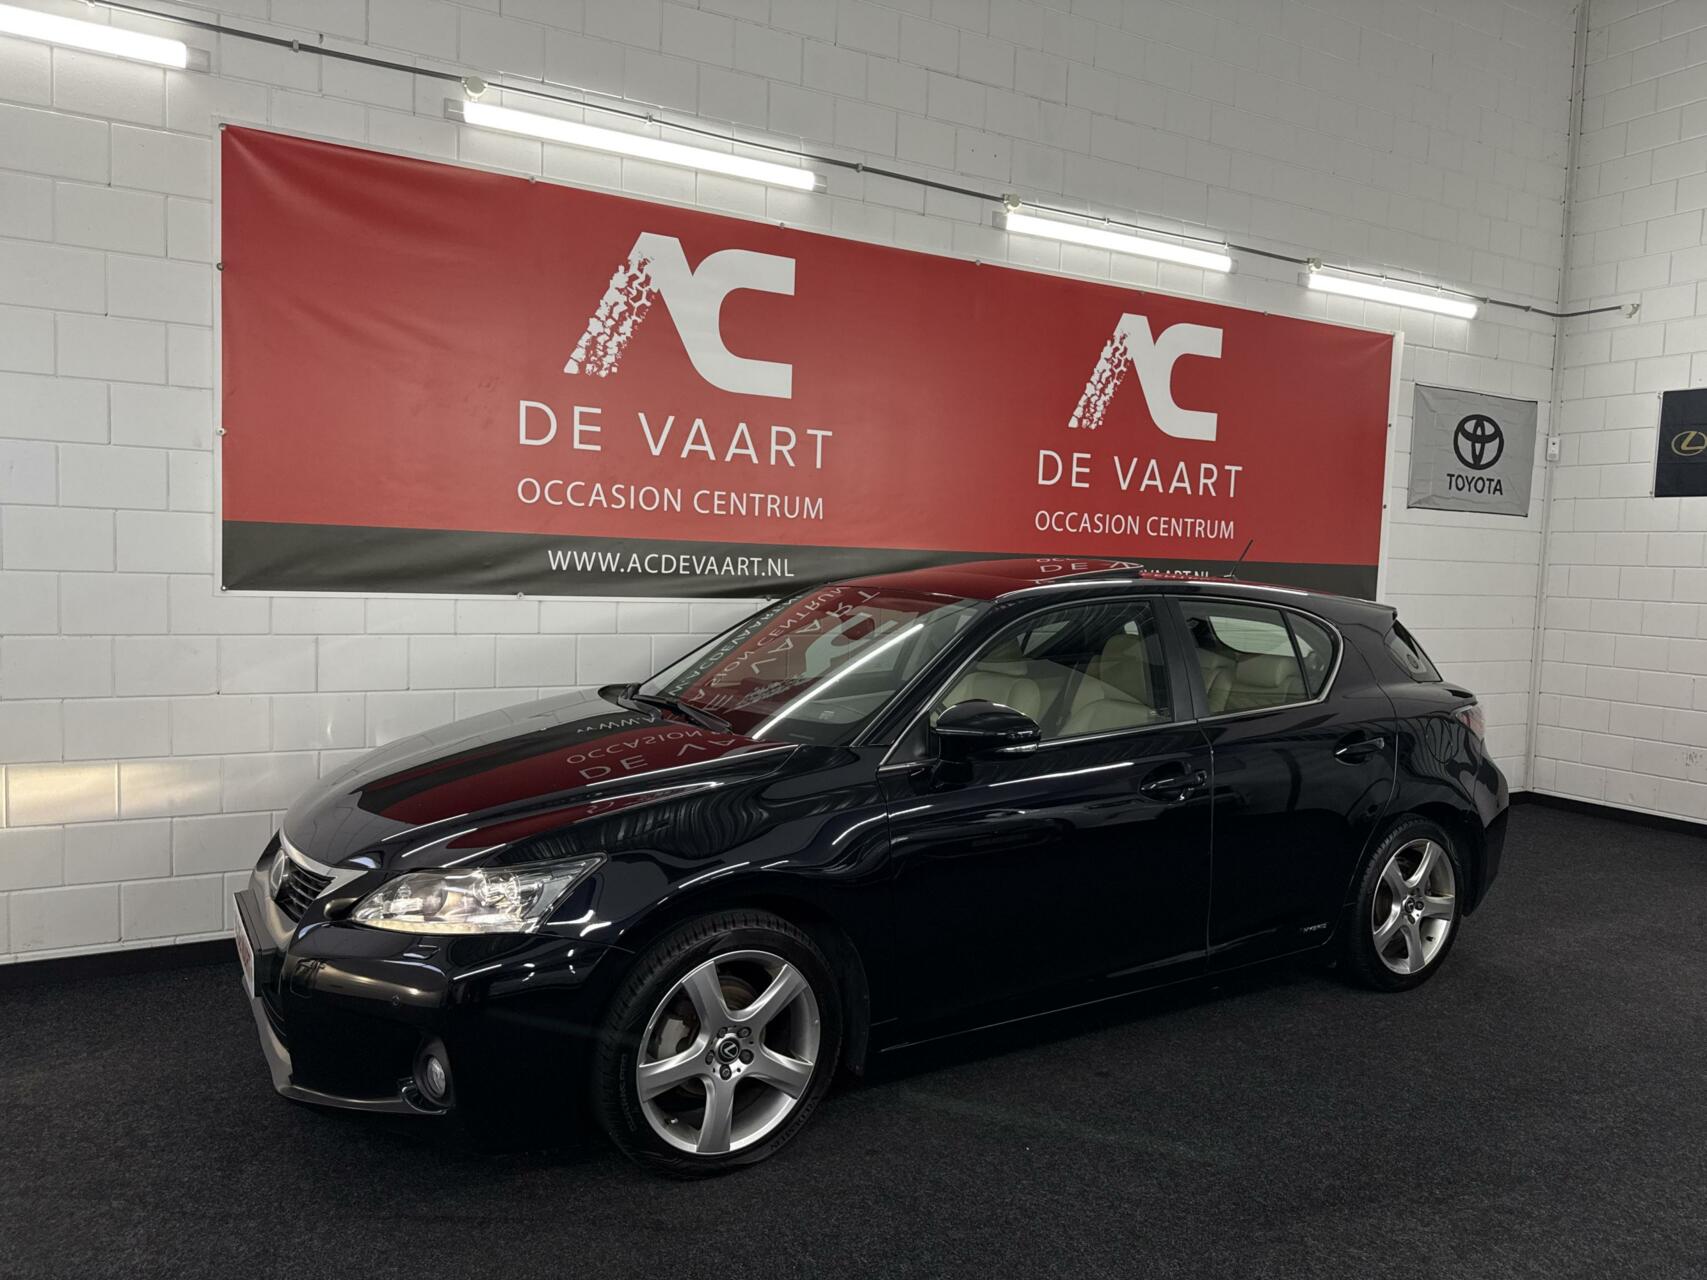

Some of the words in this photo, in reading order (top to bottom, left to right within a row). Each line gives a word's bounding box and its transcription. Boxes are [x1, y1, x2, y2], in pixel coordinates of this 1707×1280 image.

[563, 231, 796, 399] AC
[1068, 312, 1223, 442] AC
[518, 400, 602, 452] DE
[638, 411, 833, 469] VAART
[1037, 449, 1091, 488] DE
[1113, 455, 1243, 498] VAART
[1446, 473, 1503, 496] TOYOTA
[516, 477, 682, 513] OCCASION
[693, 489, 824, 521] CENTRUM
[1034, 510, 1140, 535] OCCASION
[1146, 516, 1235, 540] CENTRUM
[547, 550, 795, 577] WWW.ACDEVAART.NL
